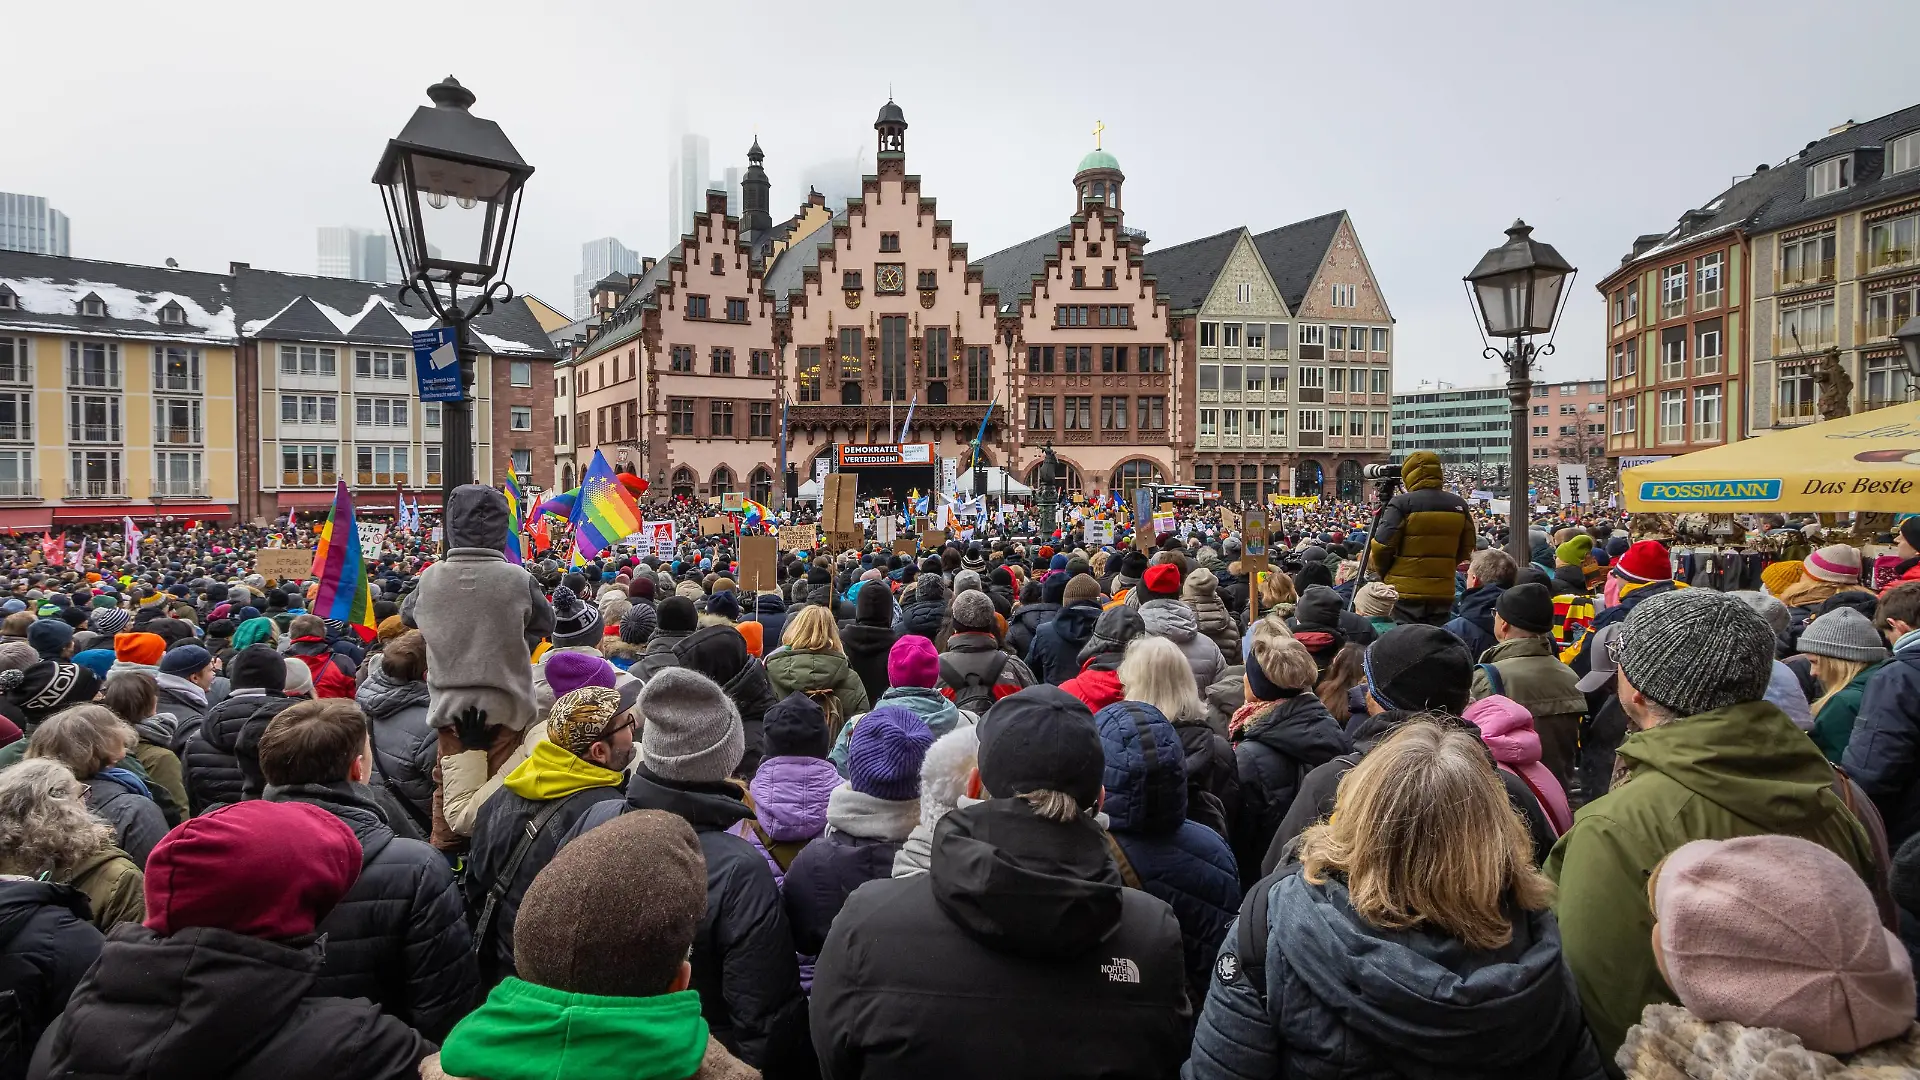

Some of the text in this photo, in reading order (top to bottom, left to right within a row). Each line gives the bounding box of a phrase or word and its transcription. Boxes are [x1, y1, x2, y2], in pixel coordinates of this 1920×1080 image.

[844, 445, 898, 454] DEMOKRATIE
[844, 455, 898, 463] VERTEIDIGEN!
[1652, 483, 1769, 498] POSSMANN
[1800, 477, 1913, 495] Das Beste
[1111, 957, 1127, 966] THE
[1100, 964, 1127, 974] NORTH
[1109, 973, 1128, 982] FACE
